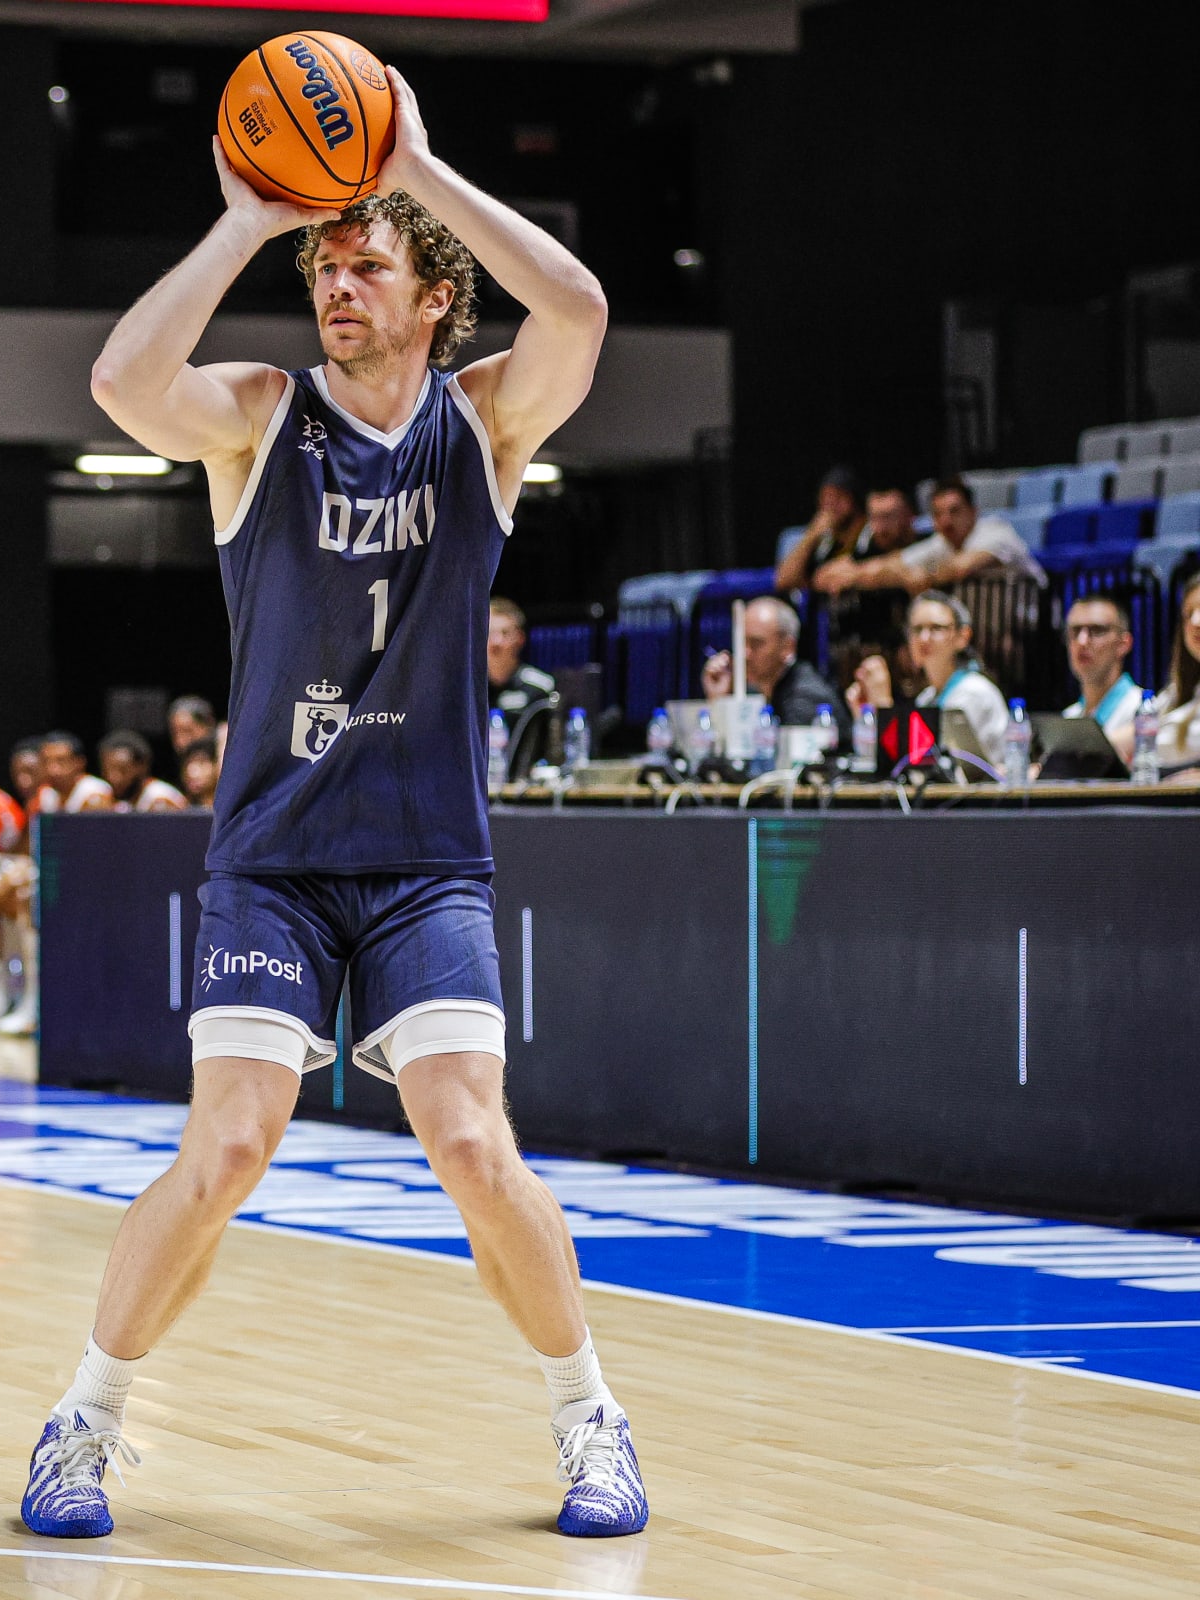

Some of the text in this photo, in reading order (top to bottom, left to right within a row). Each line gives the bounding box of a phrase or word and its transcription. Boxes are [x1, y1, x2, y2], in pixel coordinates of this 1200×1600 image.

[239, 107, 266, 147] FIBA
[284, 40, 354, 151] Wilson
[318, 484, 436, 555] DZIKI
[367, 578, 389, 651] 1
[222, 951, 304, 985] InPost
